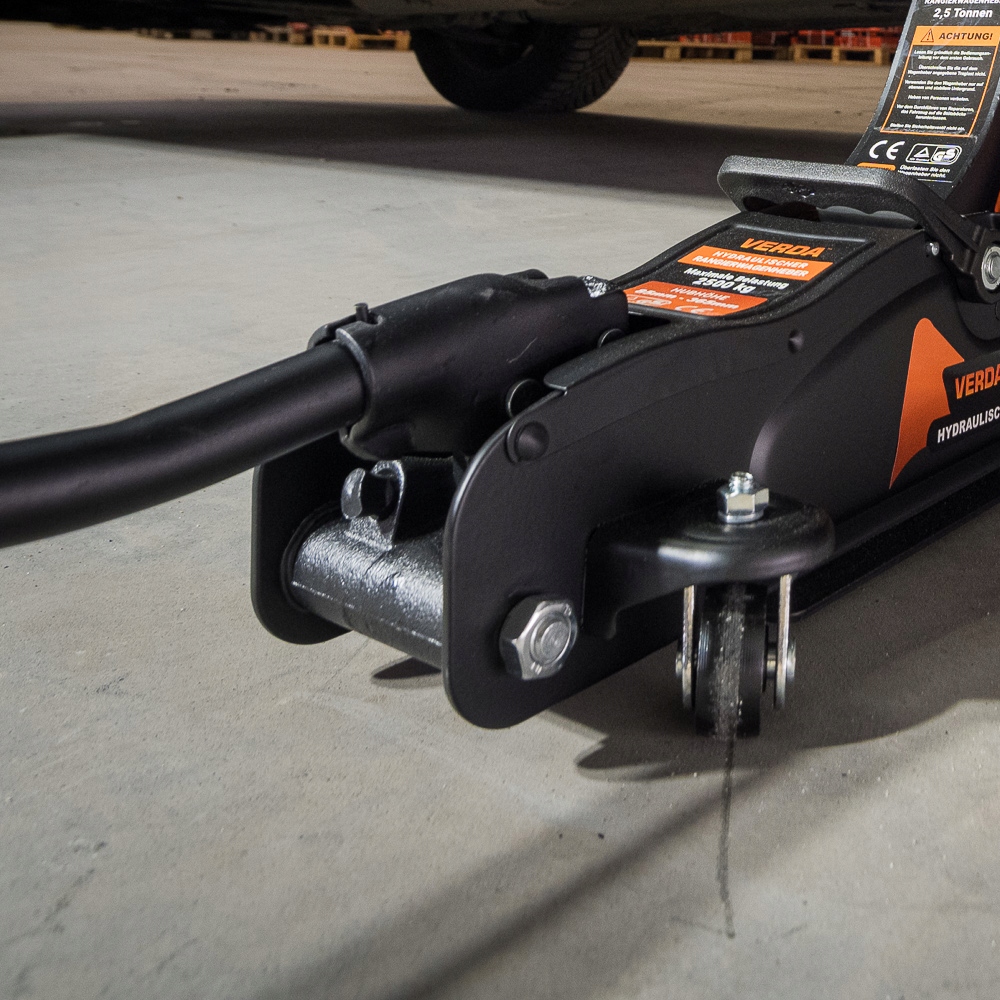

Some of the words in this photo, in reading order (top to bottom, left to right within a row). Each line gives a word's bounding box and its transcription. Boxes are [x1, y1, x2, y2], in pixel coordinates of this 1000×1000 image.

[933, 8, 951, 19] 2,5
[954, 8, 993, 18] Tonnen
[939, 32, 993, 41] ACHTUNG!
[869, 140, 905, 160] CE
[740, 238, 826, 258] VERDA
[692, 255, 809, 277] RANGIERWAGENHEBER
[712, 250, 809, 269] HYDRAULISCHER
[683, 268, 734, 281] Maximale
[734, 275, 790, 290] Belastung
[692, 277, 734, 289] 2500
[733, 282, 757, 294] kg
[670, 287, 730, 301] HUBHÖHE
